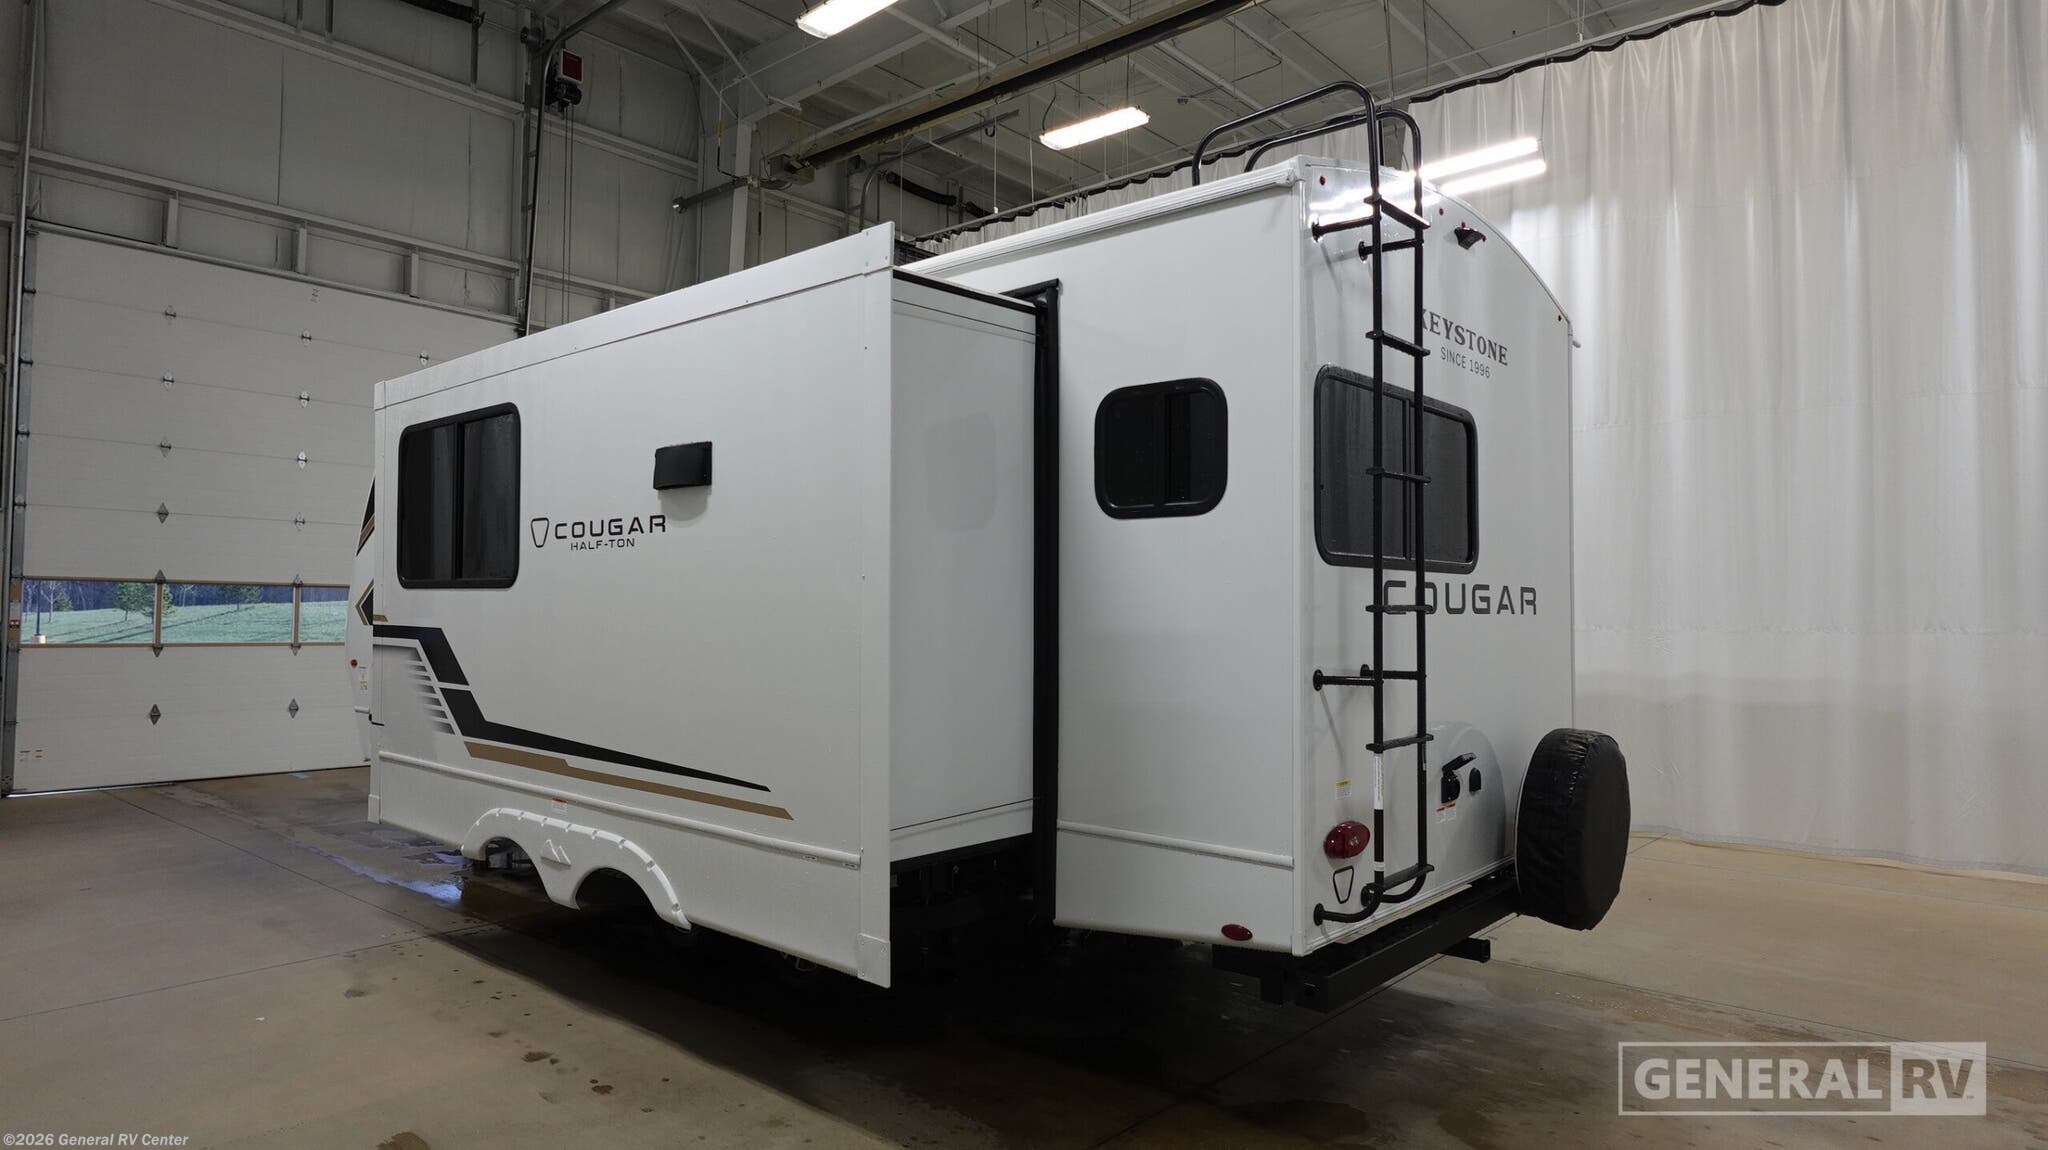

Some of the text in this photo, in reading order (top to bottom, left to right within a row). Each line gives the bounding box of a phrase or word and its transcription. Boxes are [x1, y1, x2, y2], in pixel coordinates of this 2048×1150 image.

[1440, 346, 1490, 379] SINCE 1996
[555, 514, 666, 540] COUGAR
[570, 538, 635, 551] HALF-TON
[1383, 580, 1537, 615] COUGAR
